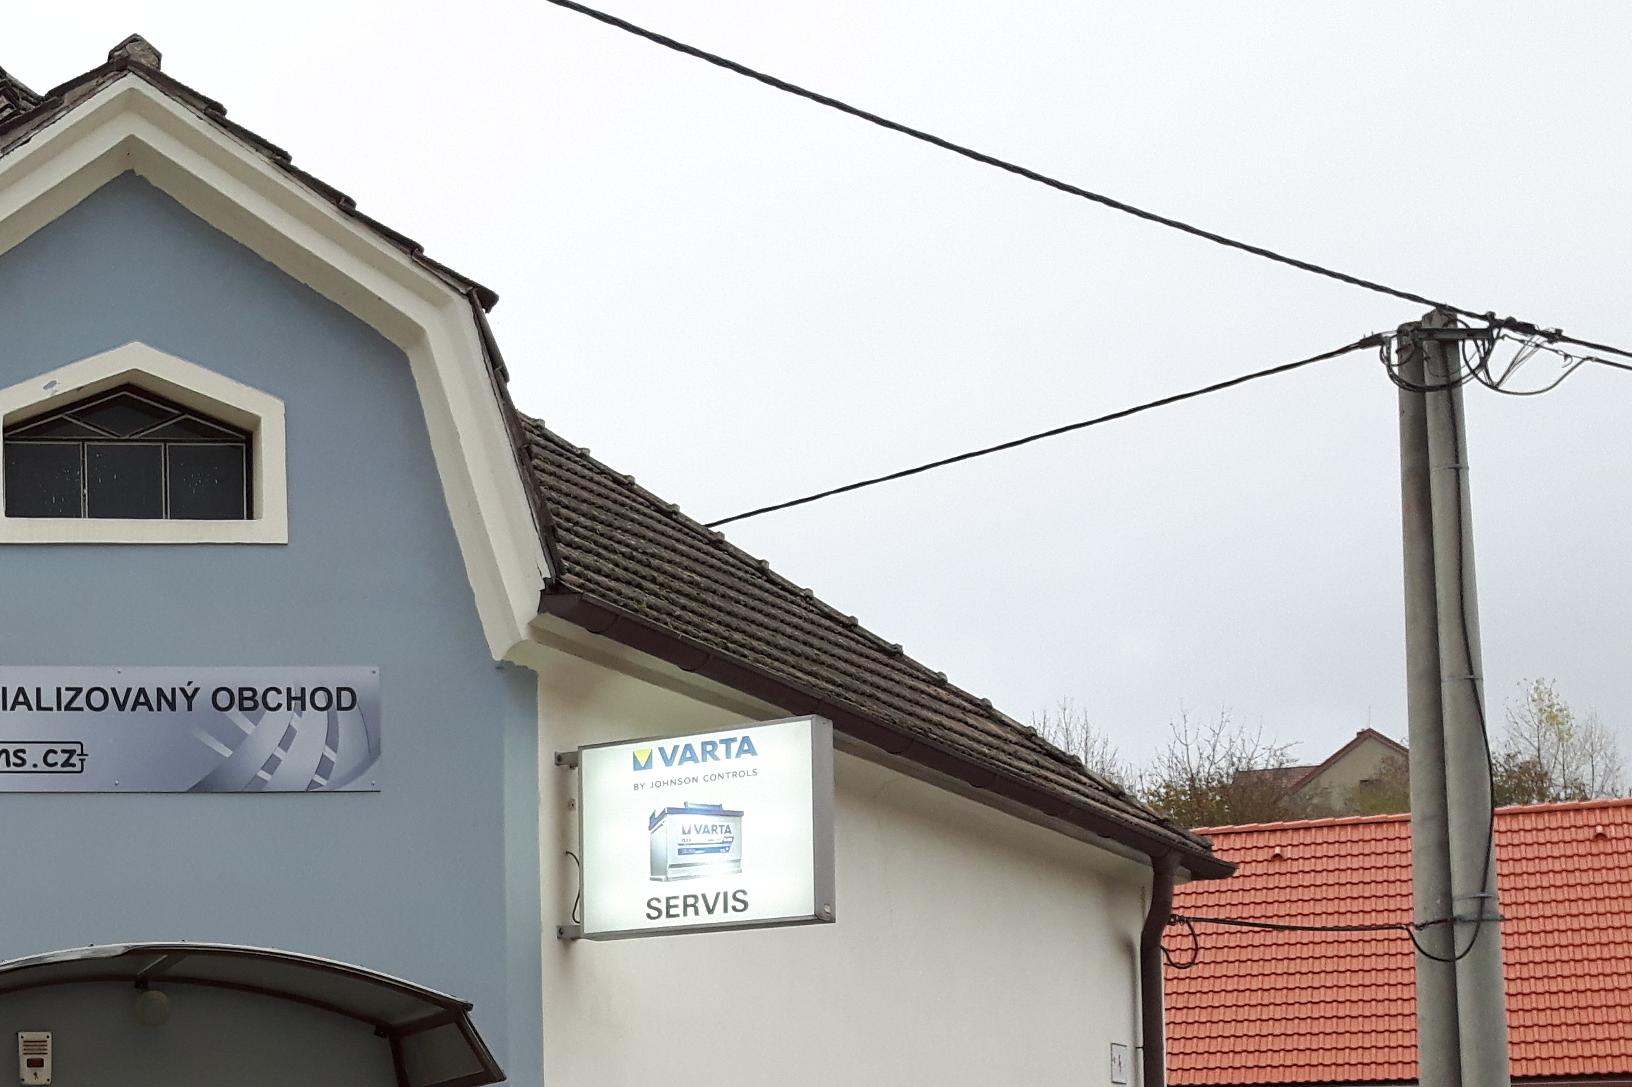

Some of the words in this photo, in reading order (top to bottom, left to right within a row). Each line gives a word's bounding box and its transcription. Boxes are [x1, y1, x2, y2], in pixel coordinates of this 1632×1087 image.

[211, 685, 358, 713] OBCHOD
[657, 735, 759, 768] VARTA
[633, 782, 646, 791] BY
[650, 775, 699, 789] JOHNSON
[703, 768, 758, 783] CONTROLS
[693, 824, 732, 835] VARTA
[645, 889, 749, 921] SERVIS
